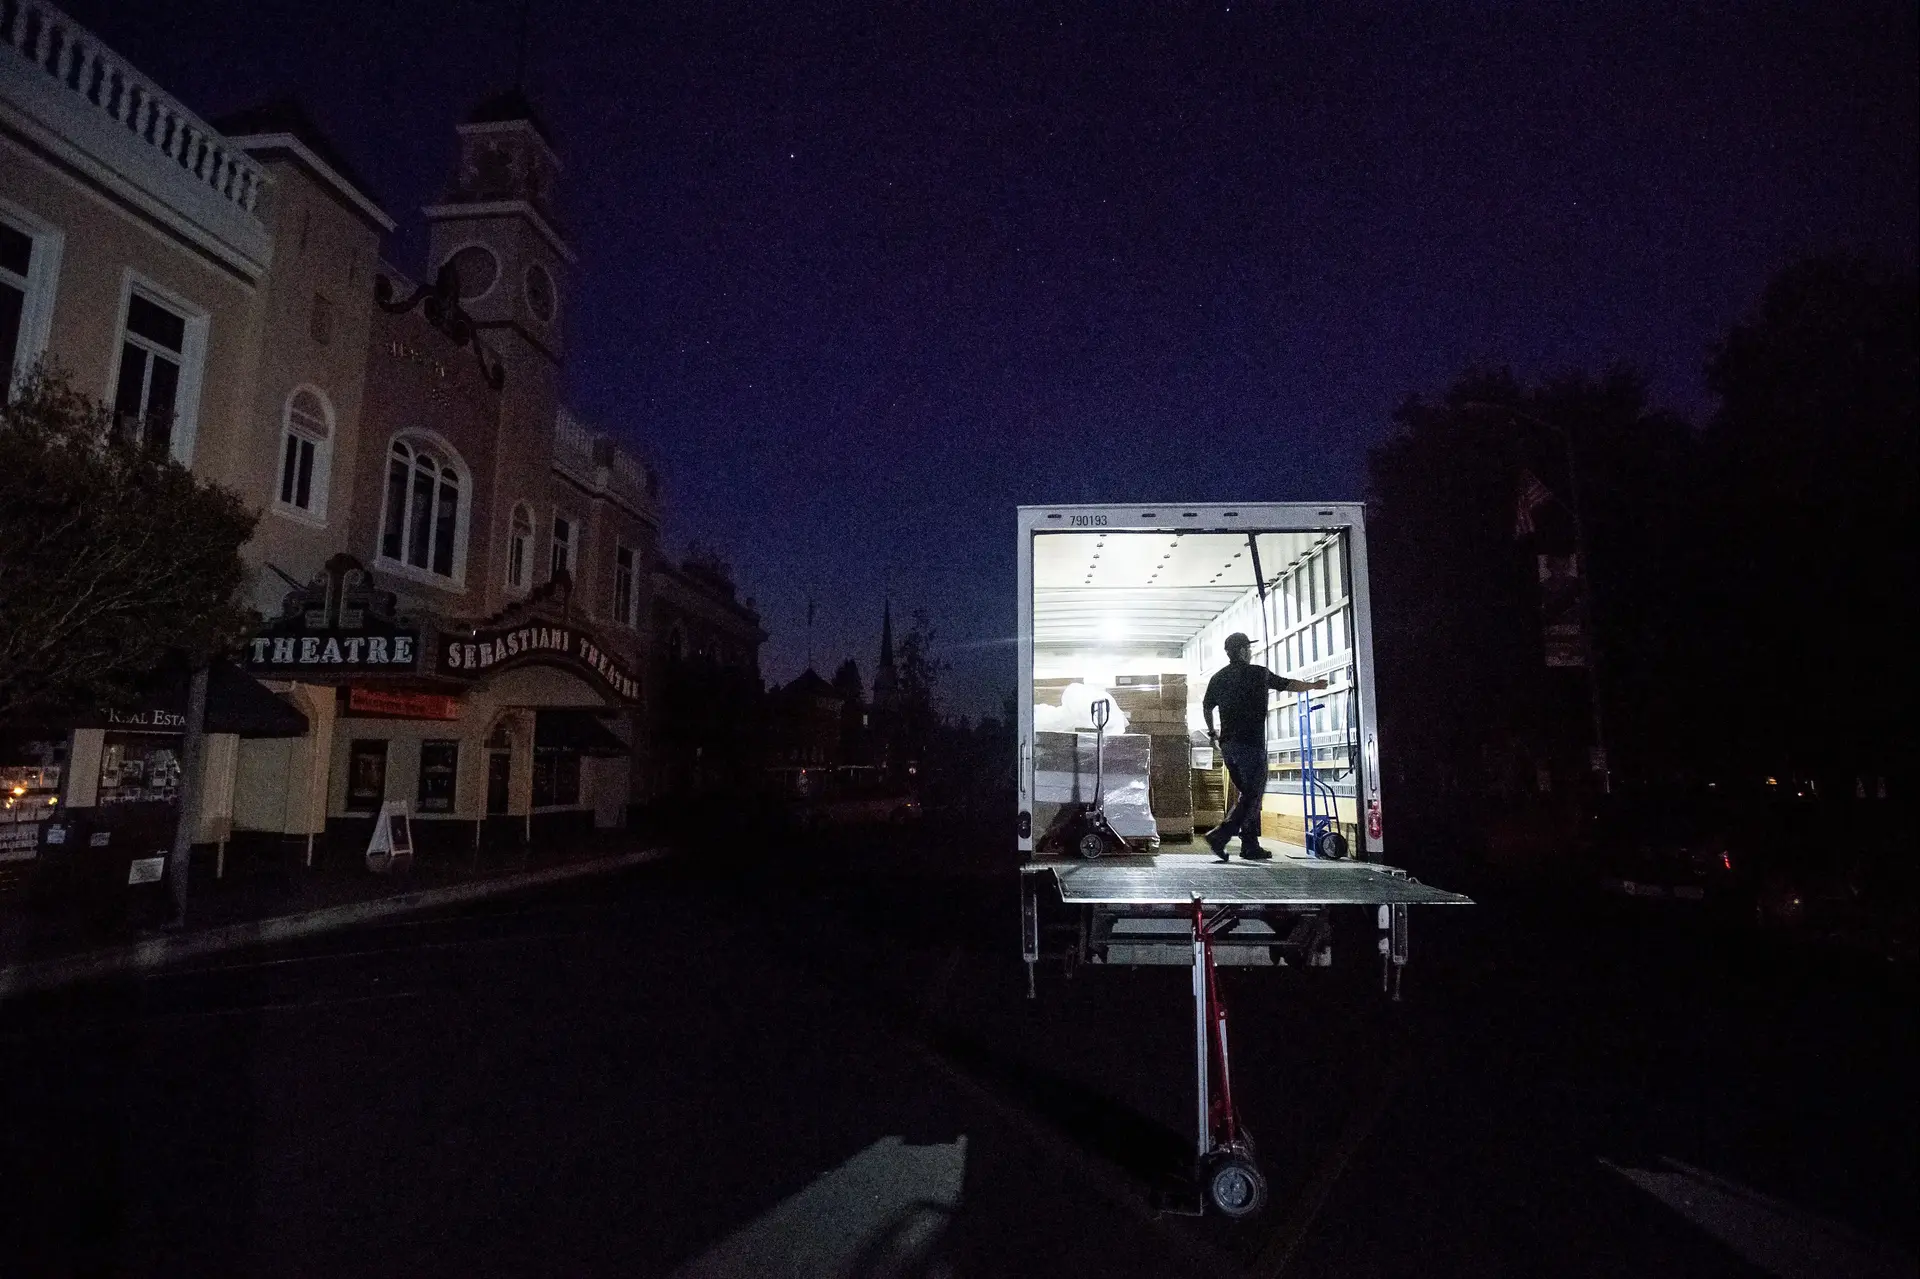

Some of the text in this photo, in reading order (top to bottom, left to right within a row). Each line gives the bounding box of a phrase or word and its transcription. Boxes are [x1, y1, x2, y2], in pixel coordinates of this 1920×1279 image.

[1070, 515, 1108, 526] 790193
[250, 637, 412, 664] THEATRE
[448, 628, 640, 700] SEBASTIANI THEATRE
[152, 709, 187, 726] ESTA
